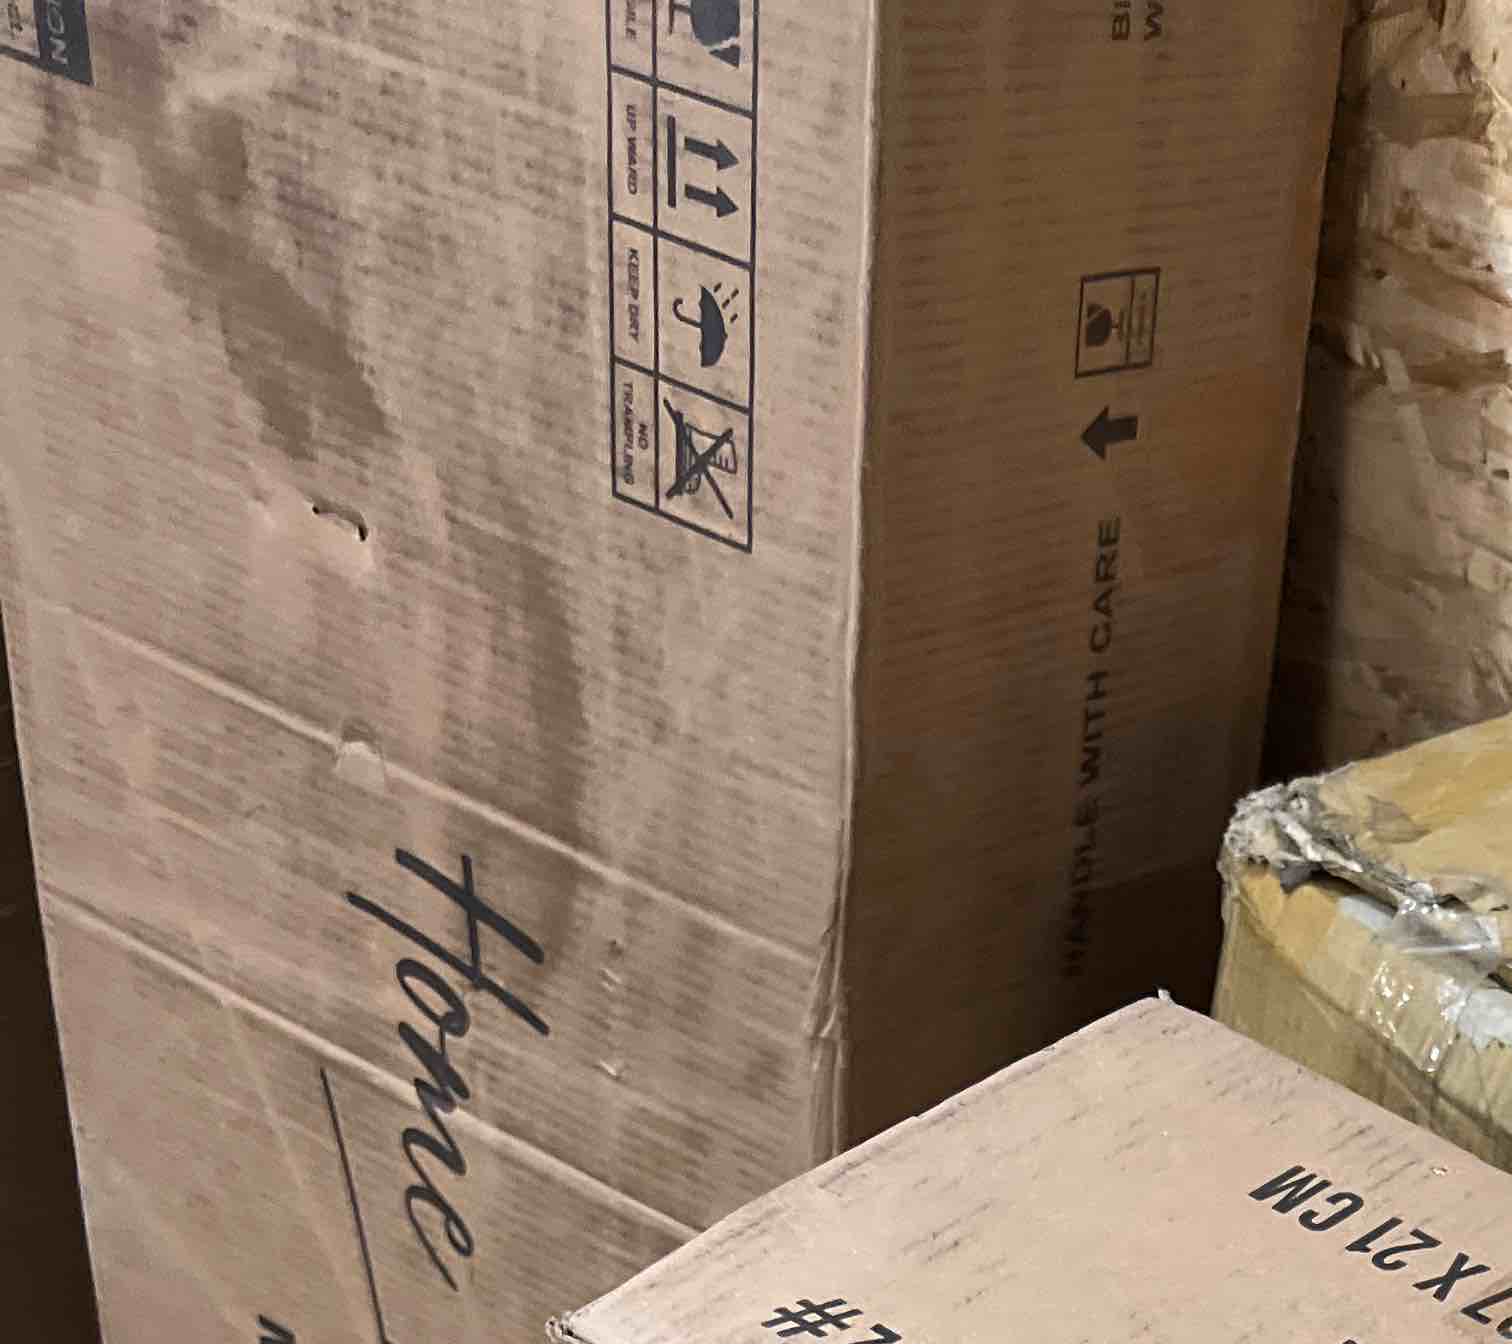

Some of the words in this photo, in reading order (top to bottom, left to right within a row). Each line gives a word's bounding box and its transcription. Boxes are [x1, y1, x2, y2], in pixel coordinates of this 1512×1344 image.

[626, 104, 637, 132] UP
[627, 137, 639, 195] WARD
[627, 248, 640, 300] KEEP
[628, 303, 640, 344] DRY
[623, 383, 635, 485] TRAMPLING
[637, 423, 649, 450] NO
[1090, 516, 1120, 654] CARE
[1078, 670, 1108, 785] WITH
[346, 847, 550, 1292] Home
[1248, 1165, 1365, 1231] CM
[1344, 1216, 1441, 1271] 21
[1413, 1252, 1491, 1302] X
